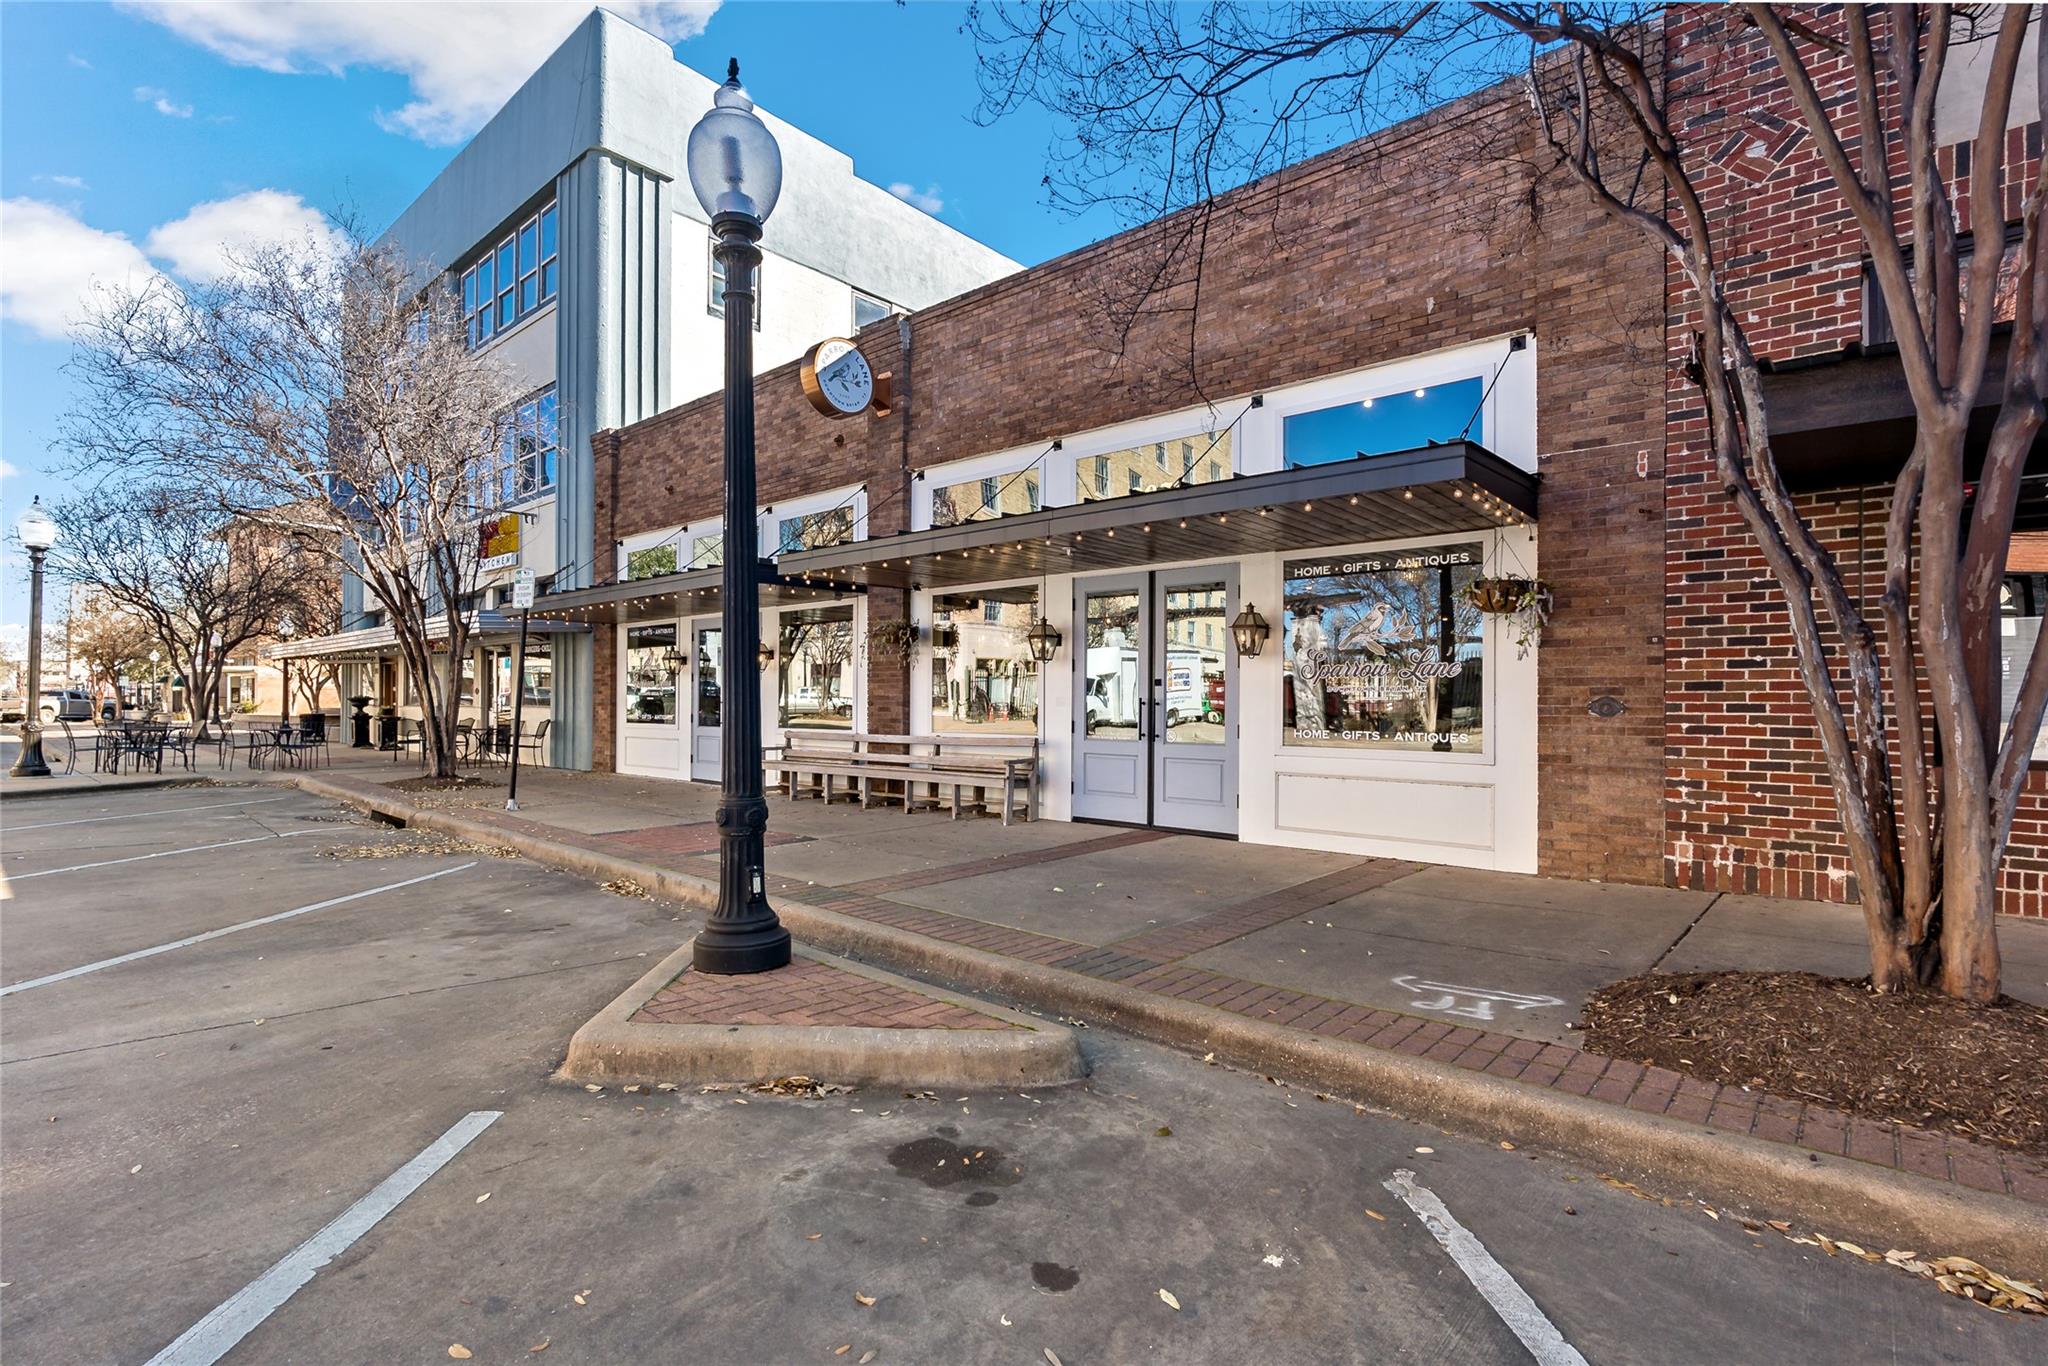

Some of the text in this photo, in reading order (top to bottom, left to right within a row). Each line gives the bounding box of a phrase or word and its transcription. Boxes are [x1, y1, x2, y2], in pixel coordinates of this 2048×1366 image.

[855, 356, 870, 386] LANE
[1294, 552, 1470, 577] HOME GIFTS ANTIQUES
[1300, 647, 1462, 685] Sparrow Lane
[1293, 729, 1469, 743] HOME GIFTS ANTIQUES
